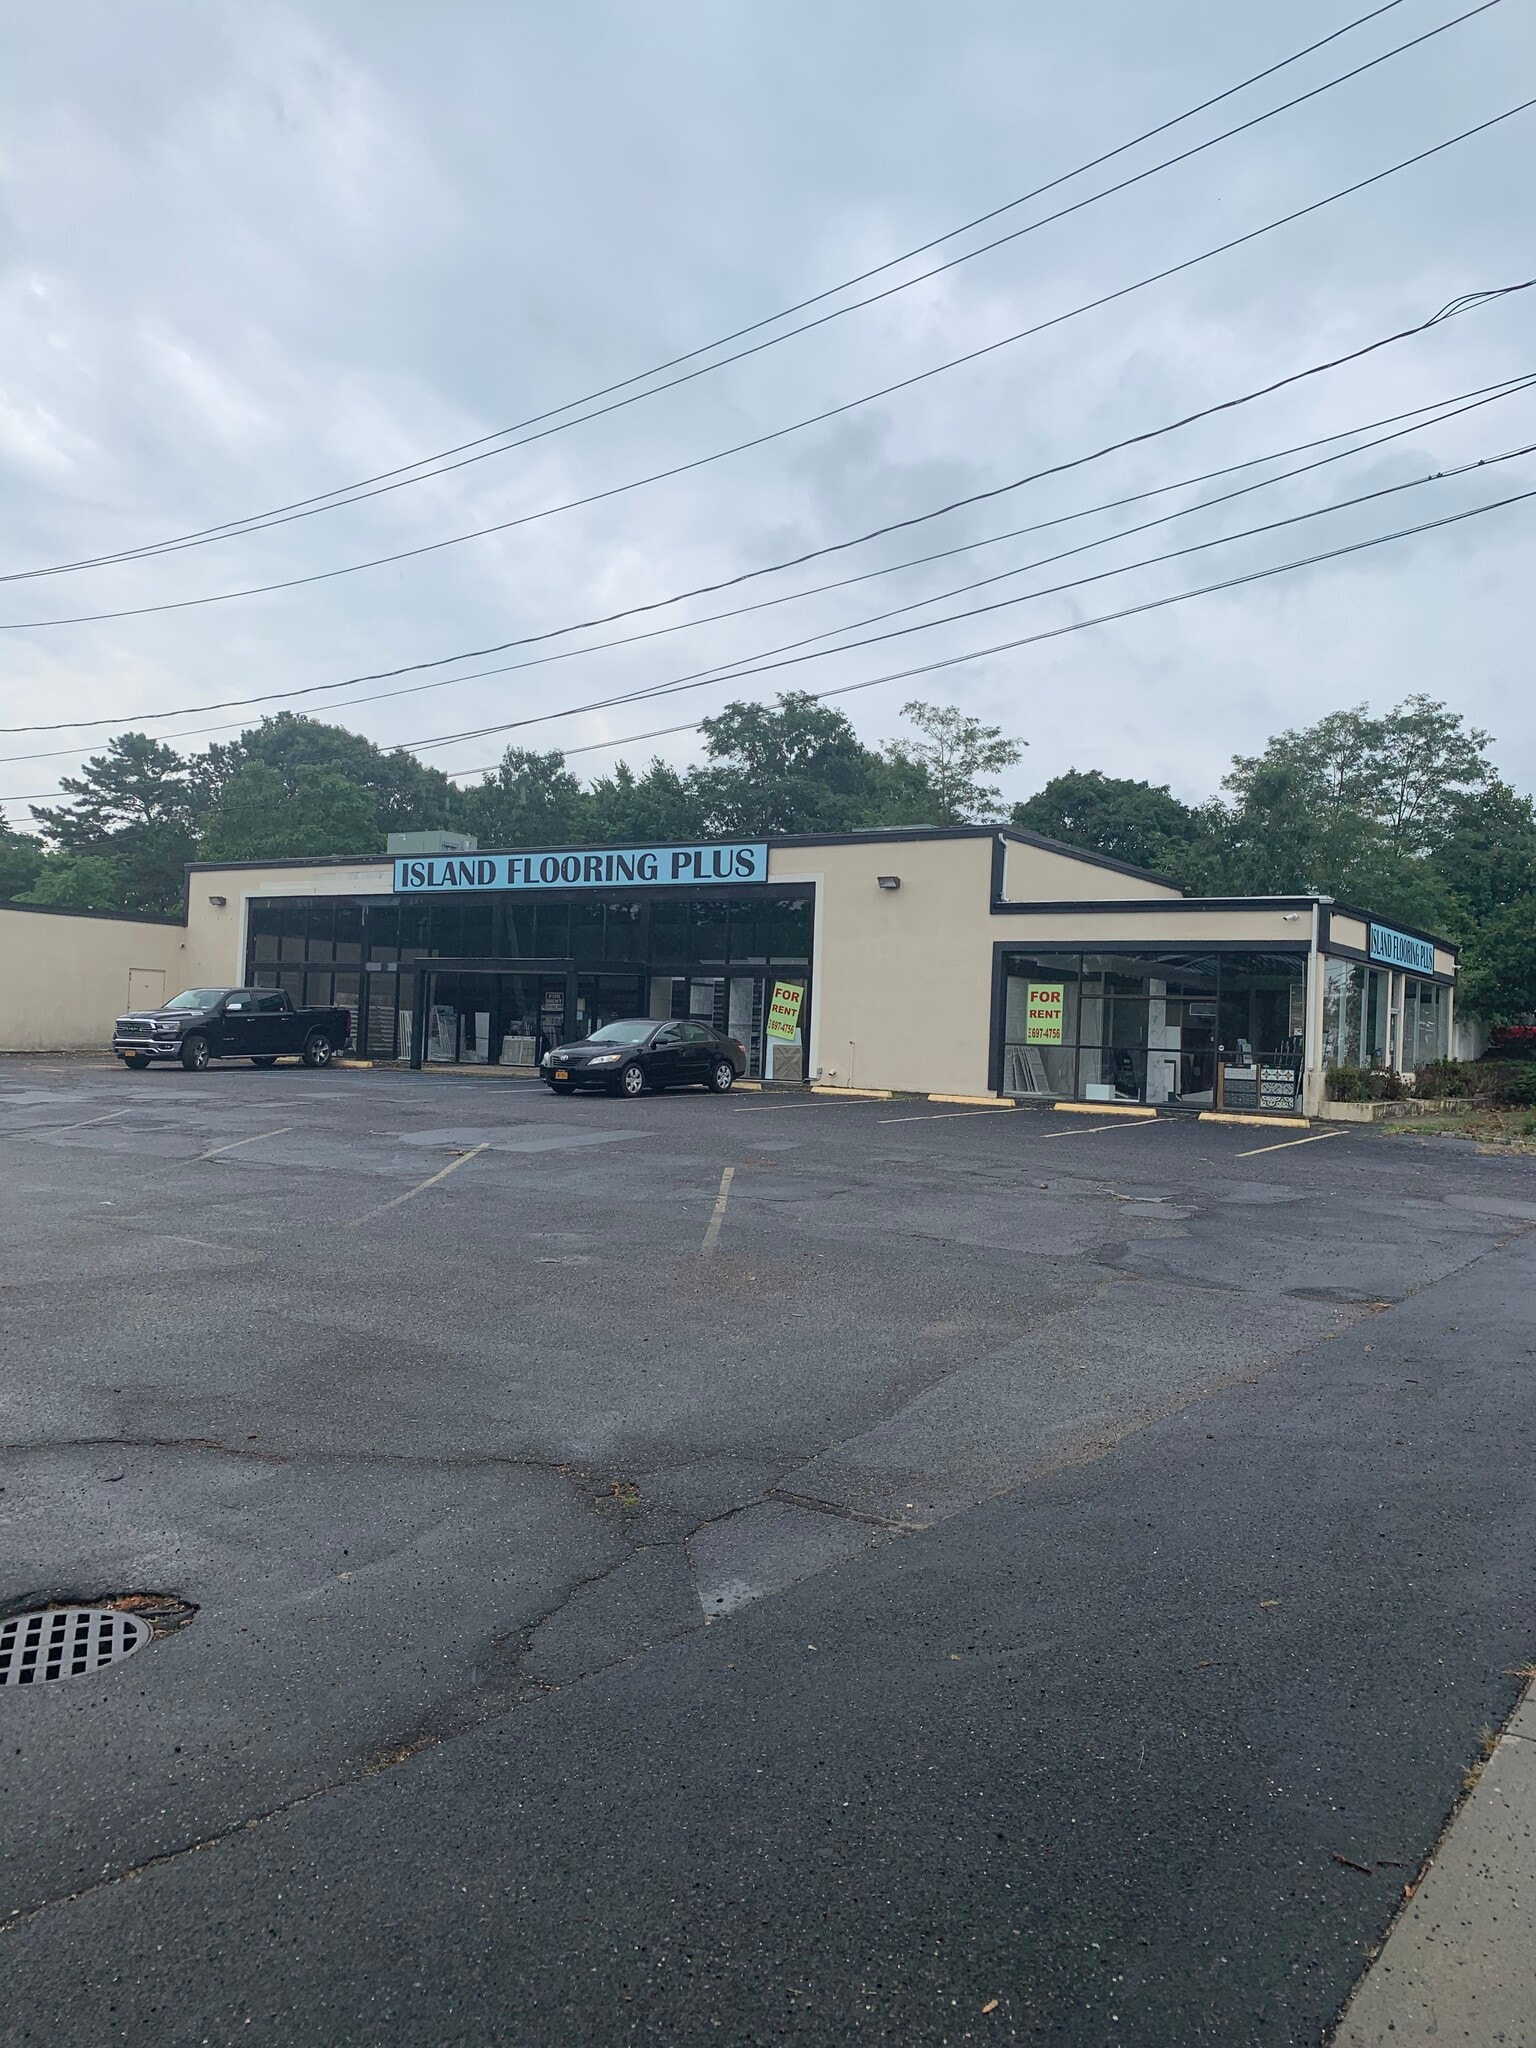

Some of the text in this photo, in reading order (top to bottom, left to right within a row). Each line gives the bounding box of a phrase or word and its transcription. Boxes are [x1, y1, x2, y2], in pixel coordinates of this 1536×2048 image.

[402, 848, 755, 888] ISLAND FLOORING PLUS
[1371, 927, 1433, 970] ISLAND FLOORING PLUS
[774, 988, 800, 1002] FOR
[1030, 991, 1061, 1003] FOR
[771, 1004, 798, 1017] RENT
[1029, 1009, 1061, 1019] RENT
[1031, 1028, 1061, 1038] 697-4756
